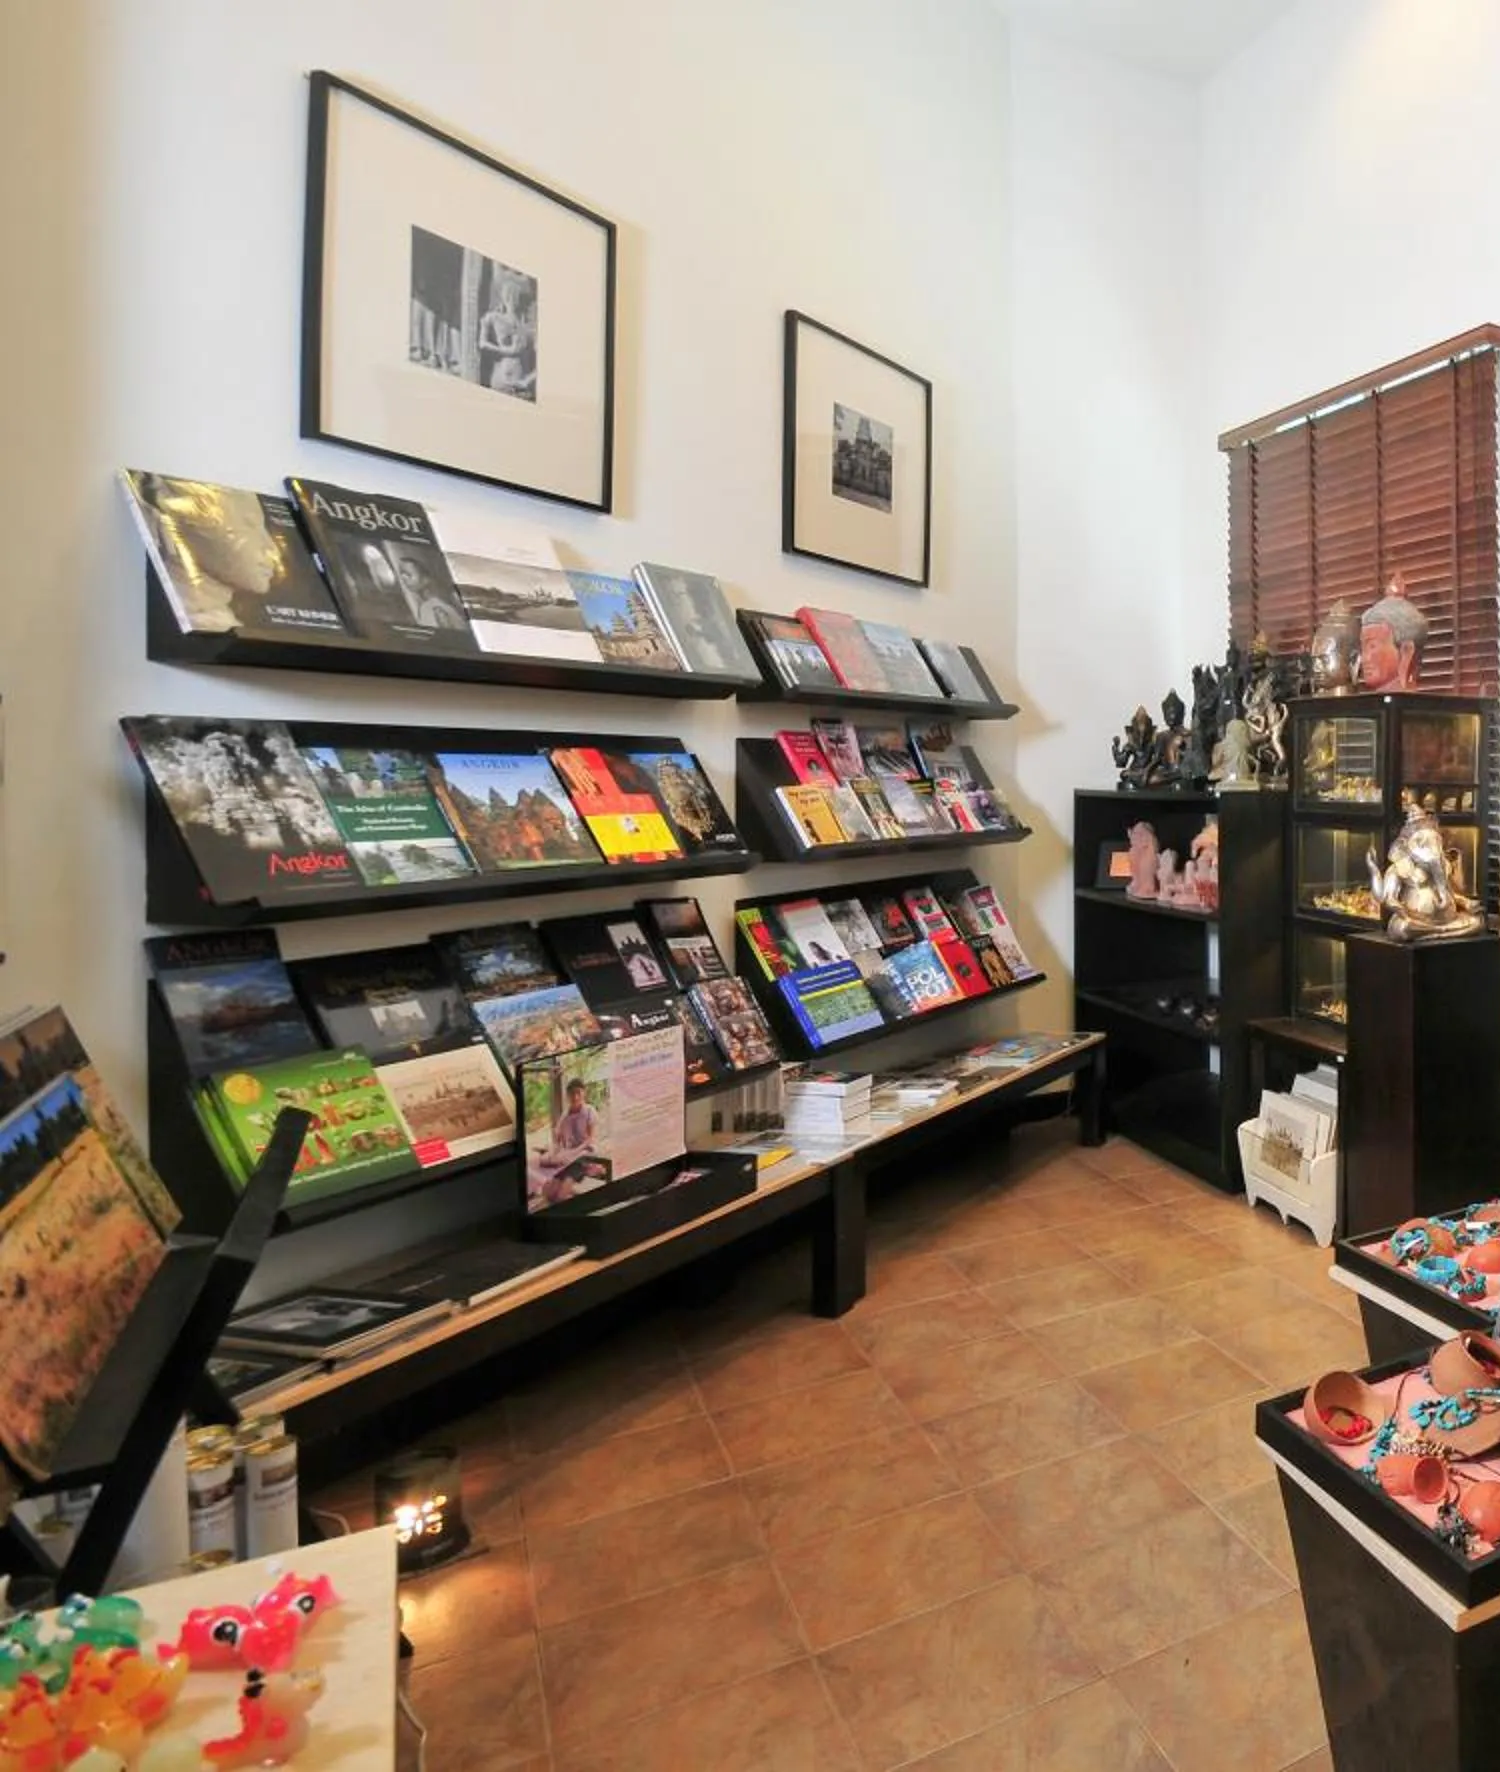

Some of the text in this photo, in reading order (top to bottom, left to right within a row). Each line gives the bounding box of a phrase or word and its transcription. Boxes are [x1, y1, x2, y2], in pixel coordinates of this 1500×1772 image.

[309, 491, 424, 533] Angkor
[270, 852, 350, 876] Angkor
[906, 966, 948, 991] POL
[912, 977, 950, 1003] POT
